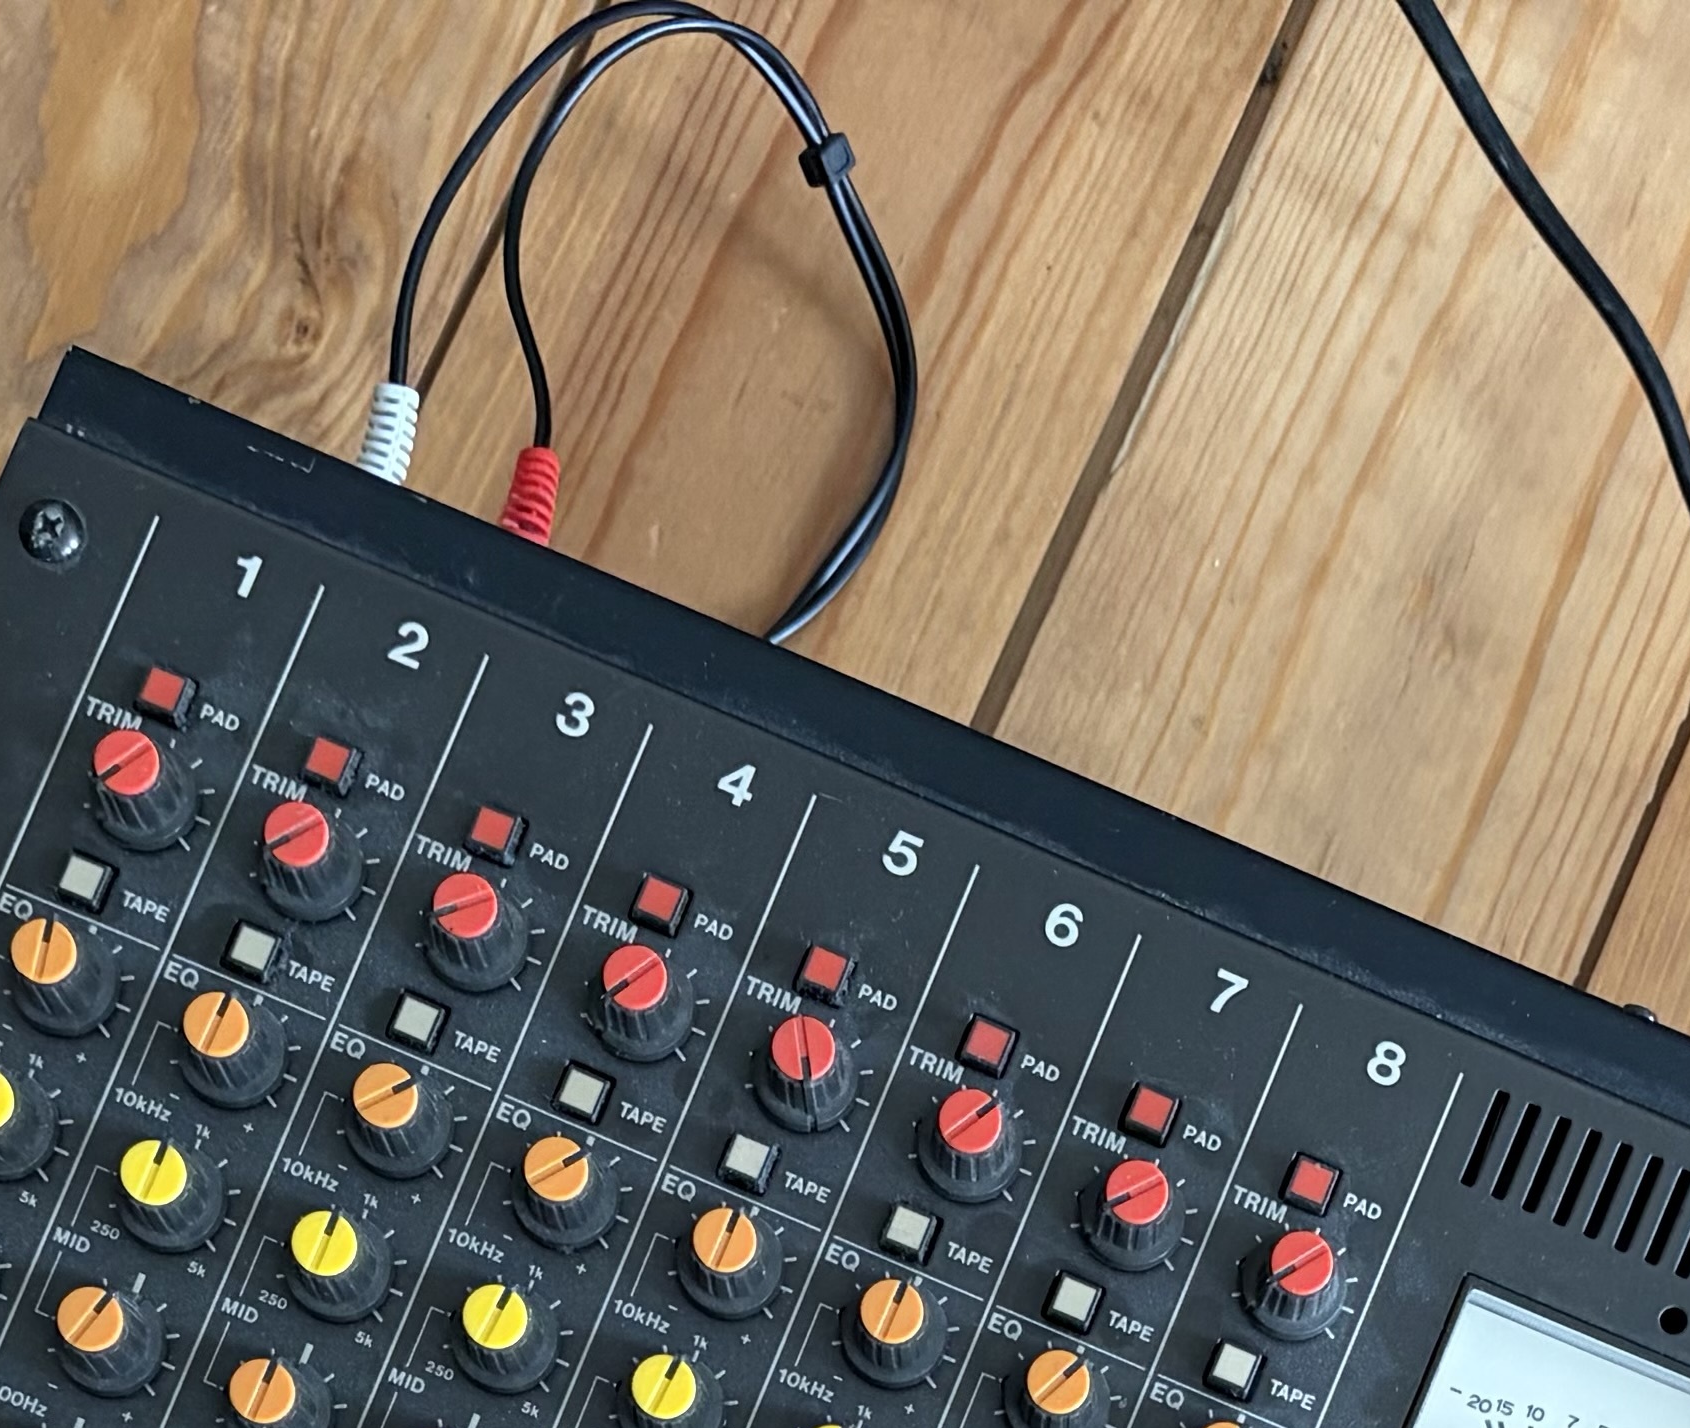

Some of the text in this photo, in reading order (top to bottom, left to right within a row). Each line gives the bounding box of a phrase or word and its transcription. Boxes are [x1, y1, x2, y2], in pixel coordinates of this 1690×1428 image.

[236, 555, 263, 599] 1
[386, 621, 430, 670] 2
[86, 695, 143, 731] TRIM
[199, 703, 240, 732] PAD
[555, 691, 595, 738] 3
[251, 763, 308, 804] TRIM
[364, 772, 406, 801] PAD
[716, 764, 757, 808] 4
[416, 833, 473, 873] TRIM
[529, 842, 570, 871] PAD
[881, 829, 925, 877] 5
[123, 889, 170, 924] TAPE
[582, 904, 639, 945] TRIM
[693, 913, 734, 941] PAD
[1044, 902, 1084, 948] 6
[163, 959, 200, 990] EQ
[288, 959, 336, 993] TAPE
[1209, 967, 1249, 1014] 7
[746, 974, 802, 1015] TRIM
[857, 983, 898, 1011] PAD
[454, 1029, 502, 1064] TAPE
[1366, 1040, 1407, 1087] 8
[909, 1044, 965, 1085] TRIM
[1020, 1053, 1061, 1082] PAD
[115, 1087, 172, 1122] 10kHz
[620, 1100, 668, 1134] TAPE
[1072, 1115, 1127, 1155] TRIM
[1182, 1123, 1222, 1152] PAD
[282, 1157, 340, 1193] 10kHz
[660, 1172, 697, 1202] EQ
[784, 1170, 832, 1204] TAPE
[1233, 1184, 1288, 1224] TRIM
[1342, 1192, 1383, 1220] PAD
[448, 1228, 505, 1264] 10kHz
[947, 1240, 994, 1275] TAPE
[528, 1264, 544, 1280] 1k
[614, 1298, 671, 1334] 10kHz
[1109, 1309, 1155, 1343] TAPE
[387, 1367, 426, 1394] MID
[424, 1360, 455, 1381] 250
[778, 1368, 835, 1403] 10kHz
[520, 1401, 539, 1418] 5k
[1149, 1381, 1185, 1410] EQ
[1270, 1378, 1317, 1411] TAPE
[1526, 1403, 1546, 1422] 10
